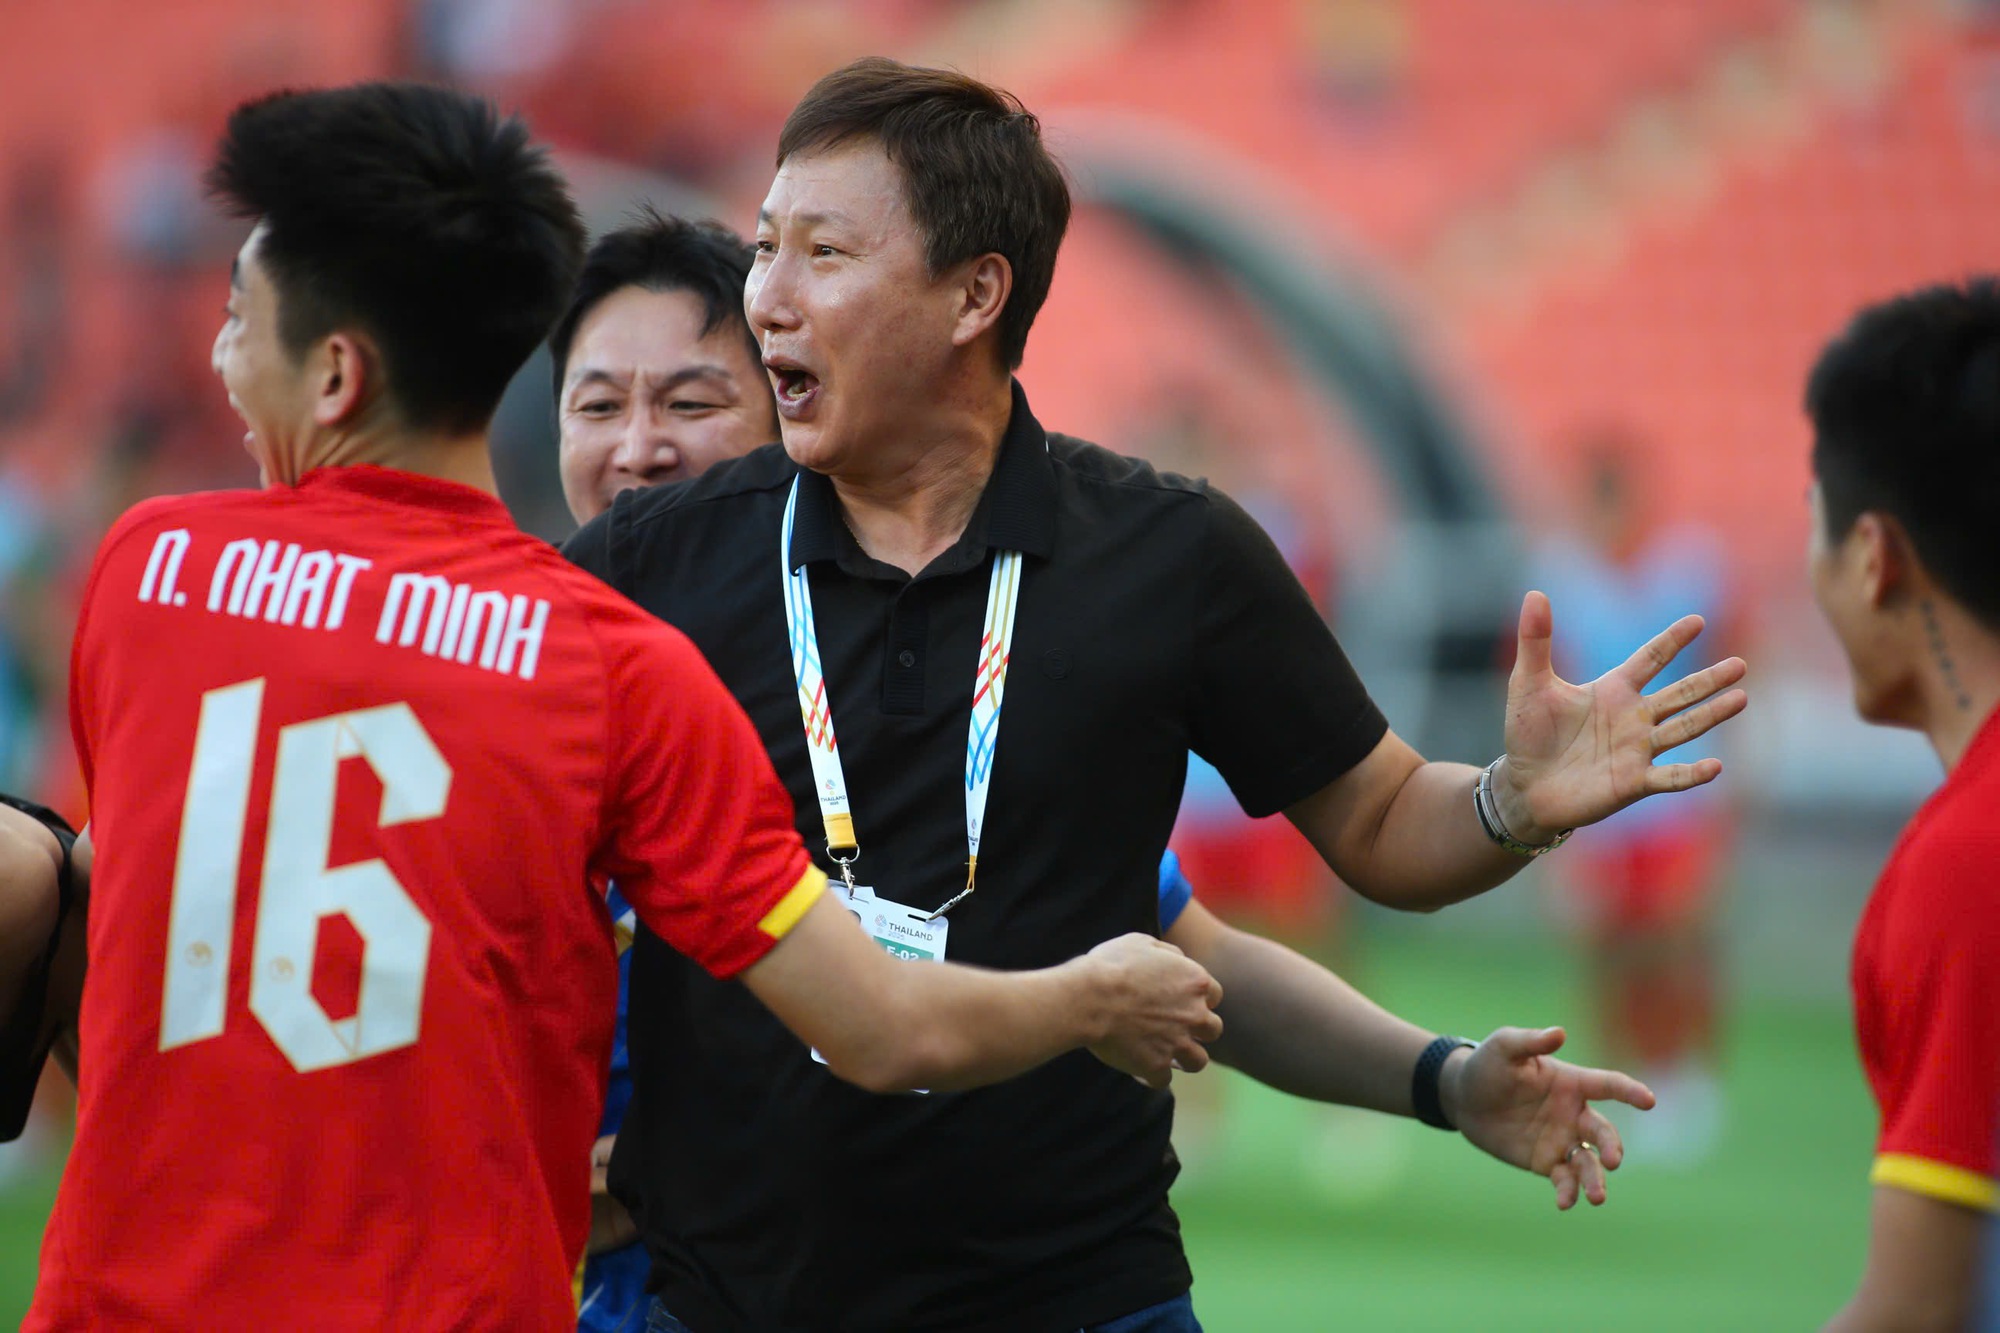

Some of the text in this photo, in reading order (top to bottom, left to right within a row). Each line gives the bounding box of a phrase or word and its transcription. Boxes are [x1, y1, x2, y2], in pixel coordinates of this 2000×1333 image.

[137, 528, 551, 680] N. NHAT MINH
[158, 676, 454, 1073] 16
[889, 922, 933, 941] THAILAND
